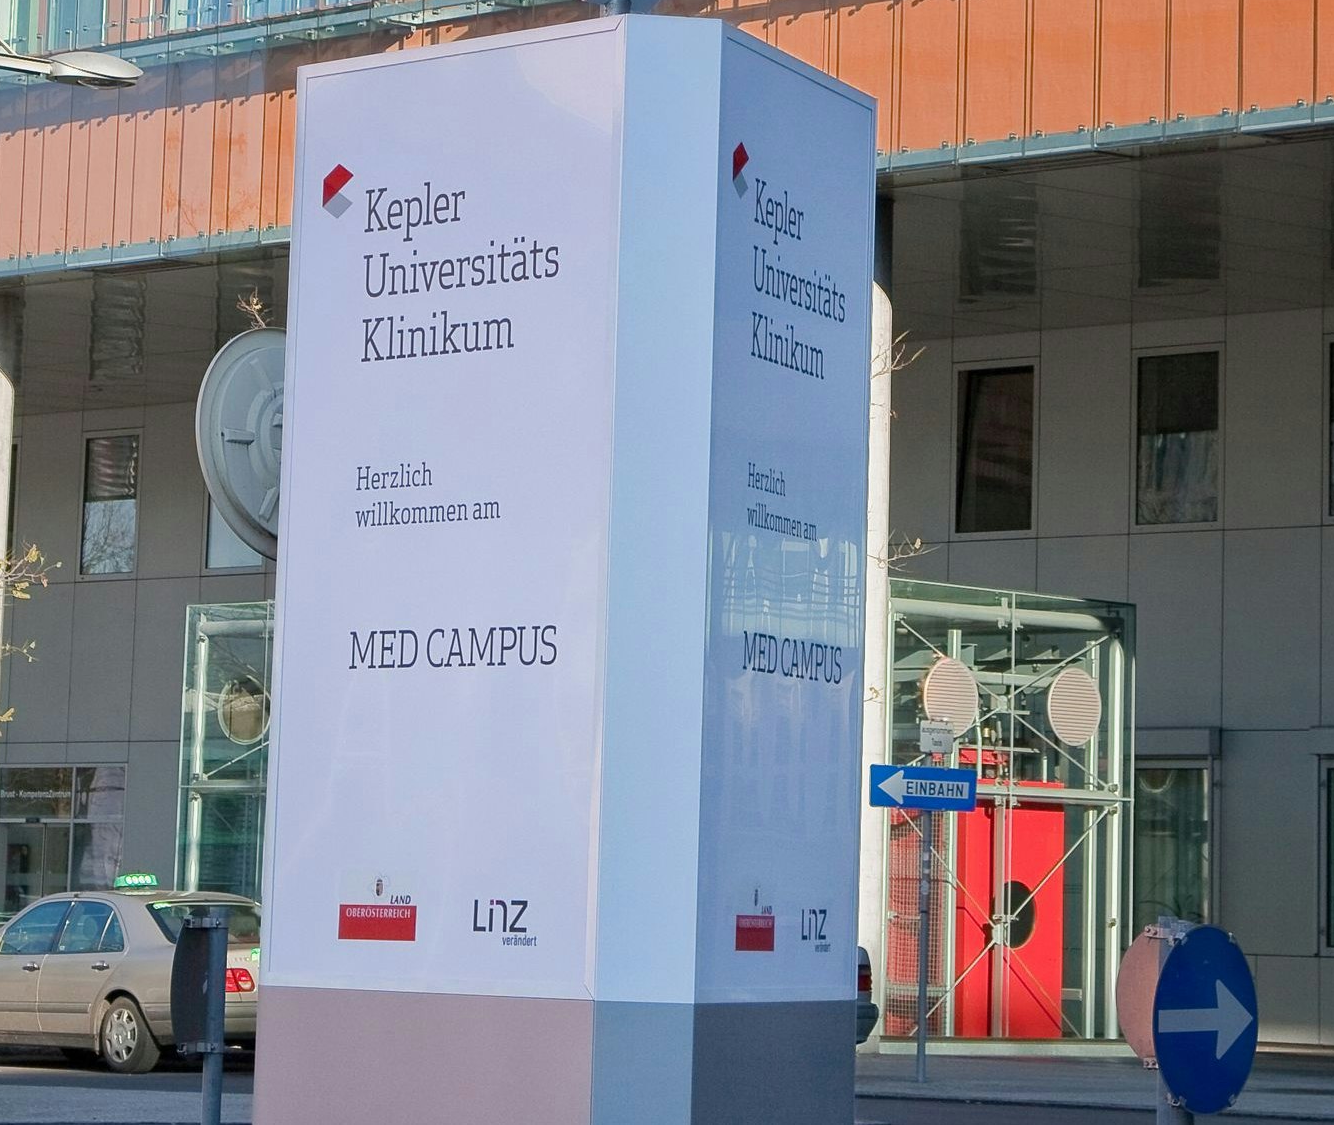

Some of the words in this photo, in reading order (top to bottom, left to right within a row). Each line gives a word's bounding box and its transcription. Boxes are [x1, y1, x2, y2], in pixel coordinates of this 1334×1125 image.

[364, 181, 466, 244] Kepler
[753, 178, 804, 246] Kepler
[363, 238, 559, 298] Universitäts
[752, 245, 846, 324] Universitäts
[360, 310, 515, 363] Klinikum
[750, 311, 825, 380] Klinikum
[355, 462, 433, 492] Herzlich
[747, 461, 786, 497] Herzlich
[355, 500, 470, 528] willkommen
[473, 501, 501, 521] am
[746, 504, 802, 539] willkommen
[803, 521, 817, 542] am
[349, 630, 419, 670] MED
[426, 624, 558, 668] CAMPUS
[742, 631, 778, 677] MED
[780, 638, 842, 685] CAMPUS
[906, 780, 964, 797] EINBAHN
[346, 906, 411, 919] OBERÖSTERREICH
[389, 895, 411, 905] LAND
[502, 934, 537, 947] verändert
